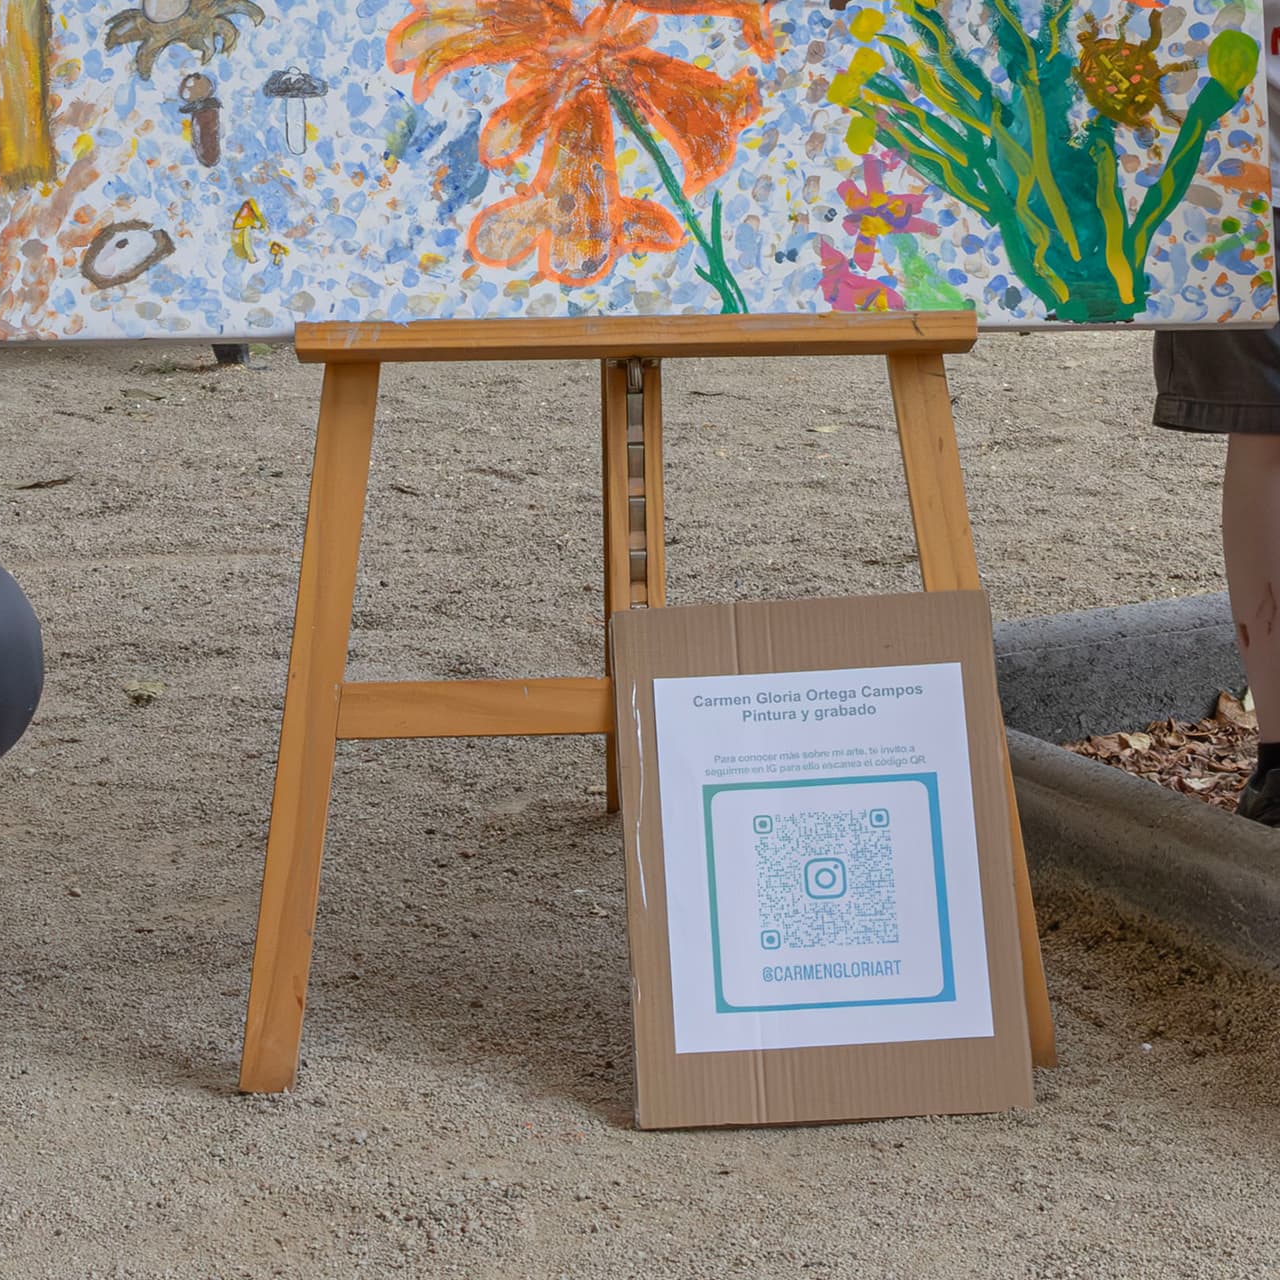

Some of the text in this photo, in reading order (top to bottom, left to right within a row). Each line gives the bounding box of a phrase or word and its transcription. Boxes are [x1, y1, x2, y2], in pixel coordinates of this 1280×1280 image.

[693, 683, 924, 708] Carmen Gloria Ortega Campos
[742, 703, 877, 723] Pintura y grabado
[704, 766, 751, 778] seguirme
[766, 762, 777, 773] IG
[780, 762, 802, 774] para
[910, 754, 927, 765] QR
[714, 754, 737, 764] Para
[738, 752, 778, 763] conocer
[802, 748, 831, 760] sobre
[763, 959, 902, 983] @CARMENGLORIART
